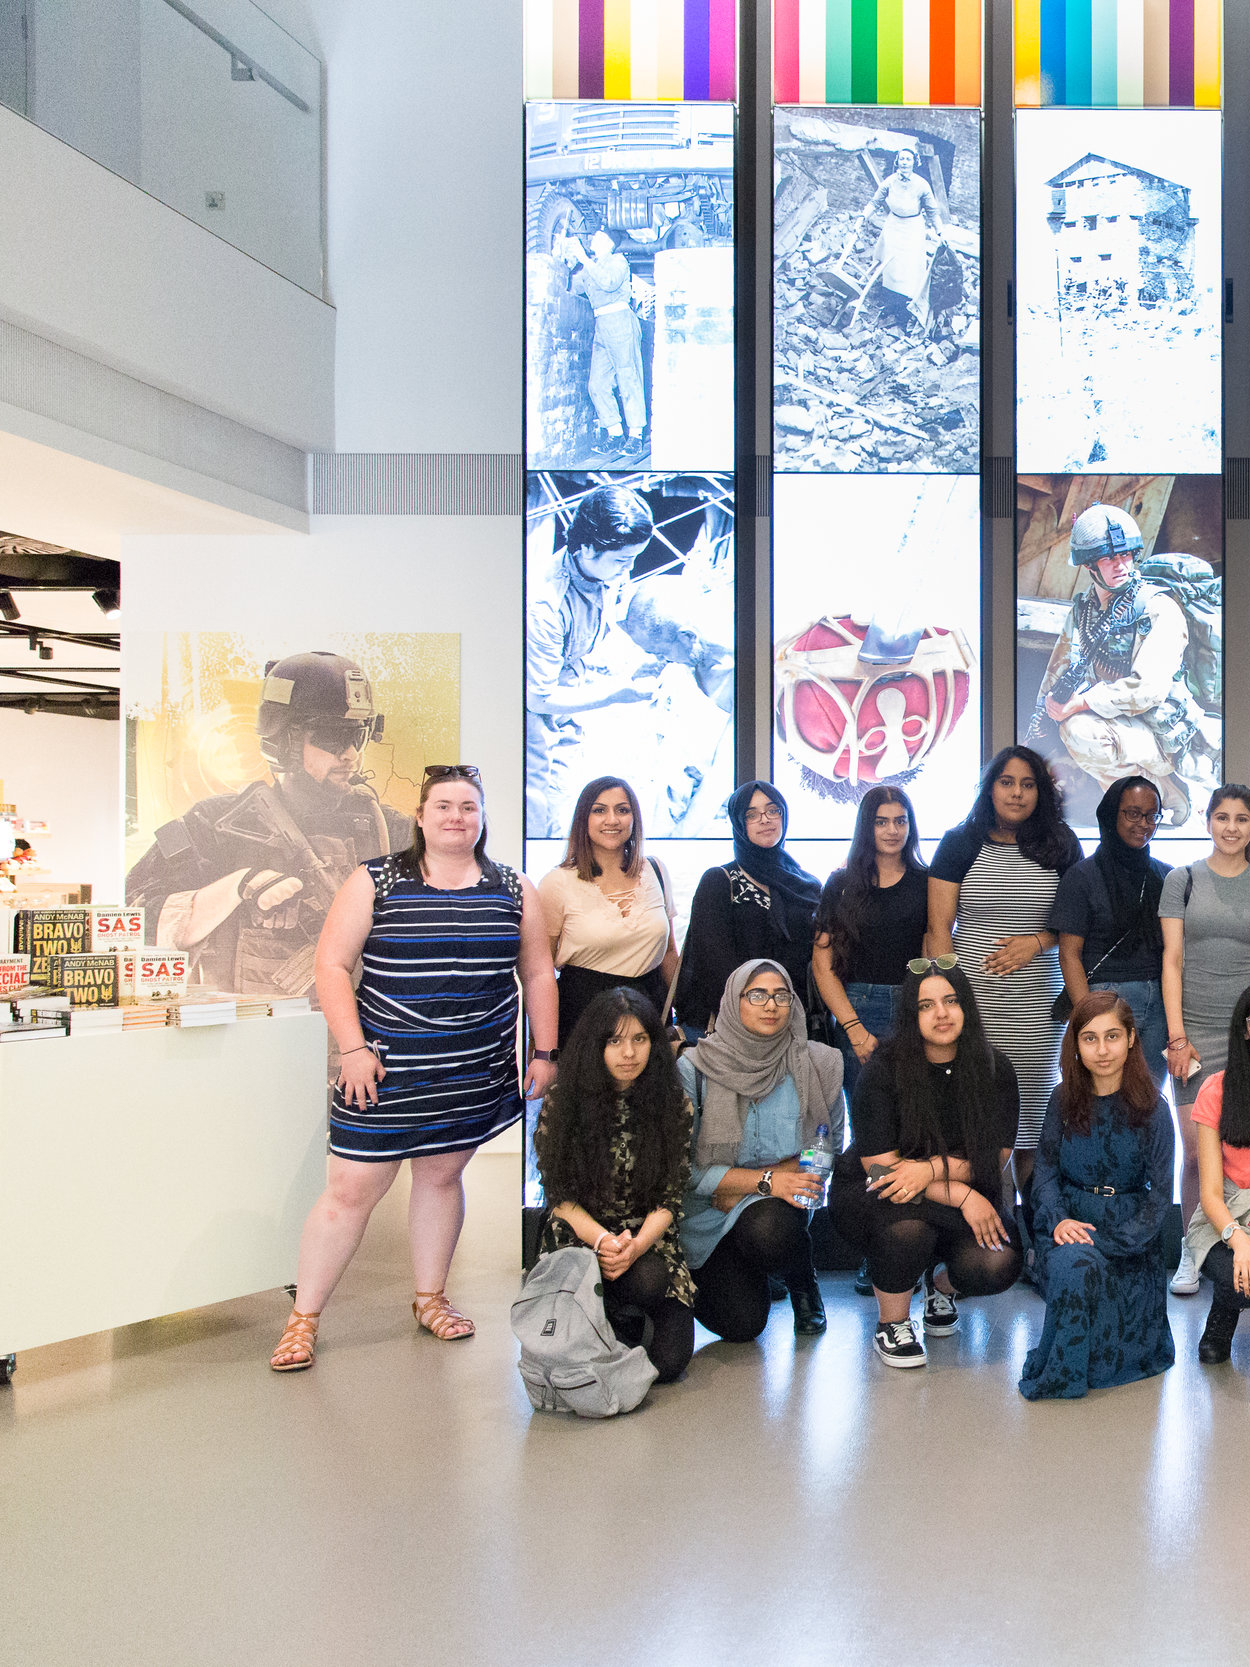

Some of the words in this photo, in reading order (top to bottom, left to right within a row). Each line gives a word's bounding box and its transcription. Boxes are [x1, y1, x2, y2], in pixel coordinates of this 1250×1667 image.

[33, 922, 84, 939] BRAVO
[97, 917, 141, 933] SAS
[33, 940, 68, 956] TWO
[141, 961, 185, 977] SAS
[0, 972, 27, 985] CIAL
[63, 969, 114, 986] BRAVO
[64, 986, 99, 1003] TWO
